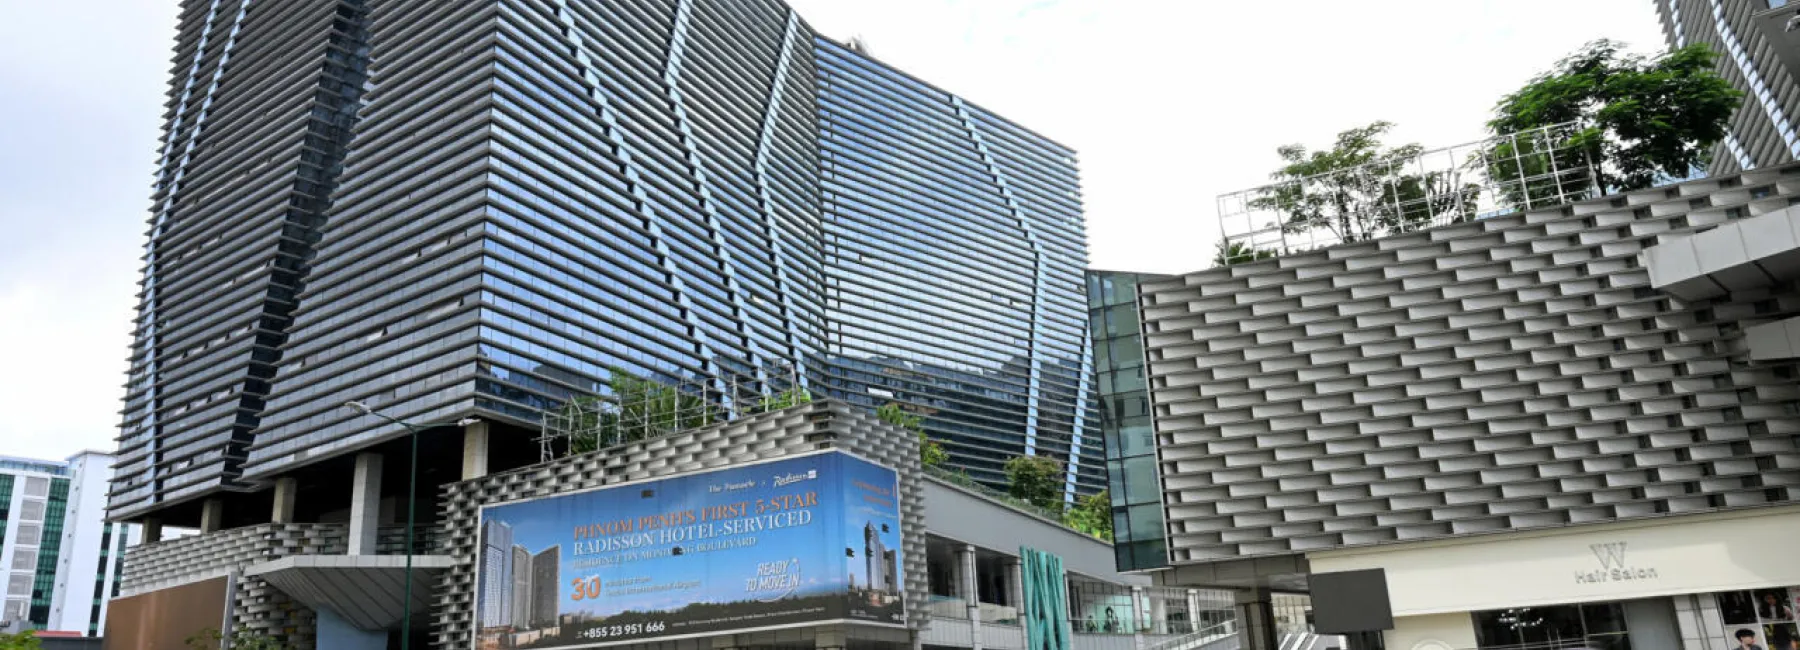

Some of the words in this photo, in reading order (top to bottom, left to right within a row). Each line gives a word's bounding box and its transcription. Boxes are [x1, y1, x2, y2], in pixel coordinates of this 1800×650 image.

[574, 518, 634, 540] PHNOM
[700, 501, 751, 522] FIRST
[754, 491, 819, 515] 5-STAR
[574, 530, 656, 556] RADISSON
[659, 509, 812, 545] HOTEL-SERVICED
[1588, 541, 1628, 569] W
[757, 560, 789, 577] READY
[1574, 570, 1607, 584] Hair
[1610, 566, 1659, 582] Salon
[571, 577, 601, 601] 30
[746, 577, 757, 592] TO
[758, 573, 786, 591] MOVE
[788, 572, 800, 588] IN
[584, 627, 607, 639] +855
[609, 625, 623, 637] 23
[624, 623, 643, 635] 951
[646, 620, 665, 633] 666
